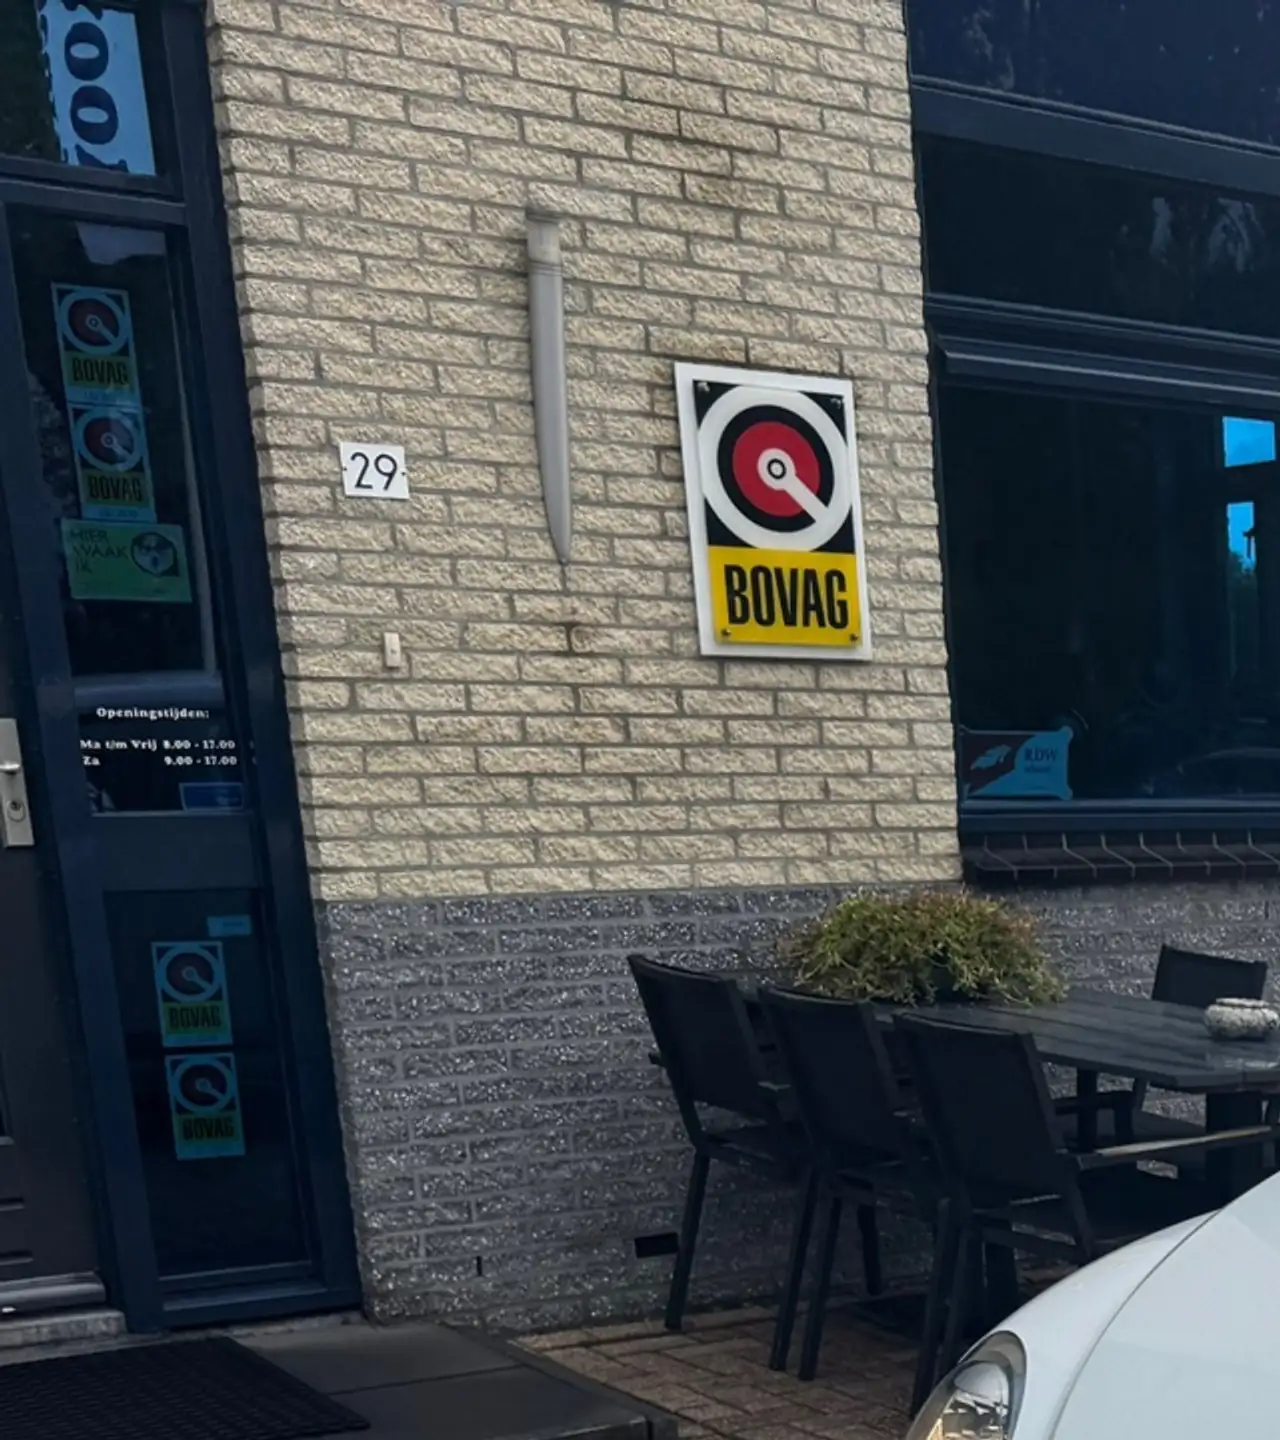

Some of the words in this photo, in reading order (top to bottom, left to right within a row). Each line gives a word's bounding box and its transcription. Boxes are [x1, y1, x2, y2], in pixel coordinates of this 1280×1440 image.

[71, 357, 129, 385] BOVAG
[350, 452, 398, 490] 29
[88, 474, 144, 502] BOVAG
[723, 564, 849, 630] BOVAG
[96, 706, 210, 721] Openingstijden:
[79, 739, 102, 750] Ma
[130, 739, 157, 752] Vrij
[202, 739, 236, 750] 17.00
[1024, 746, 1059, 762] RDW
[82, 755, 101, 766] Za
[164, 755, 193, 766] 9.00
[204, 755, 238, 766] 17.00
[168, 1005, 222, 1030] BOVAG
[181, 1116, 235, 1141] BOVAG
